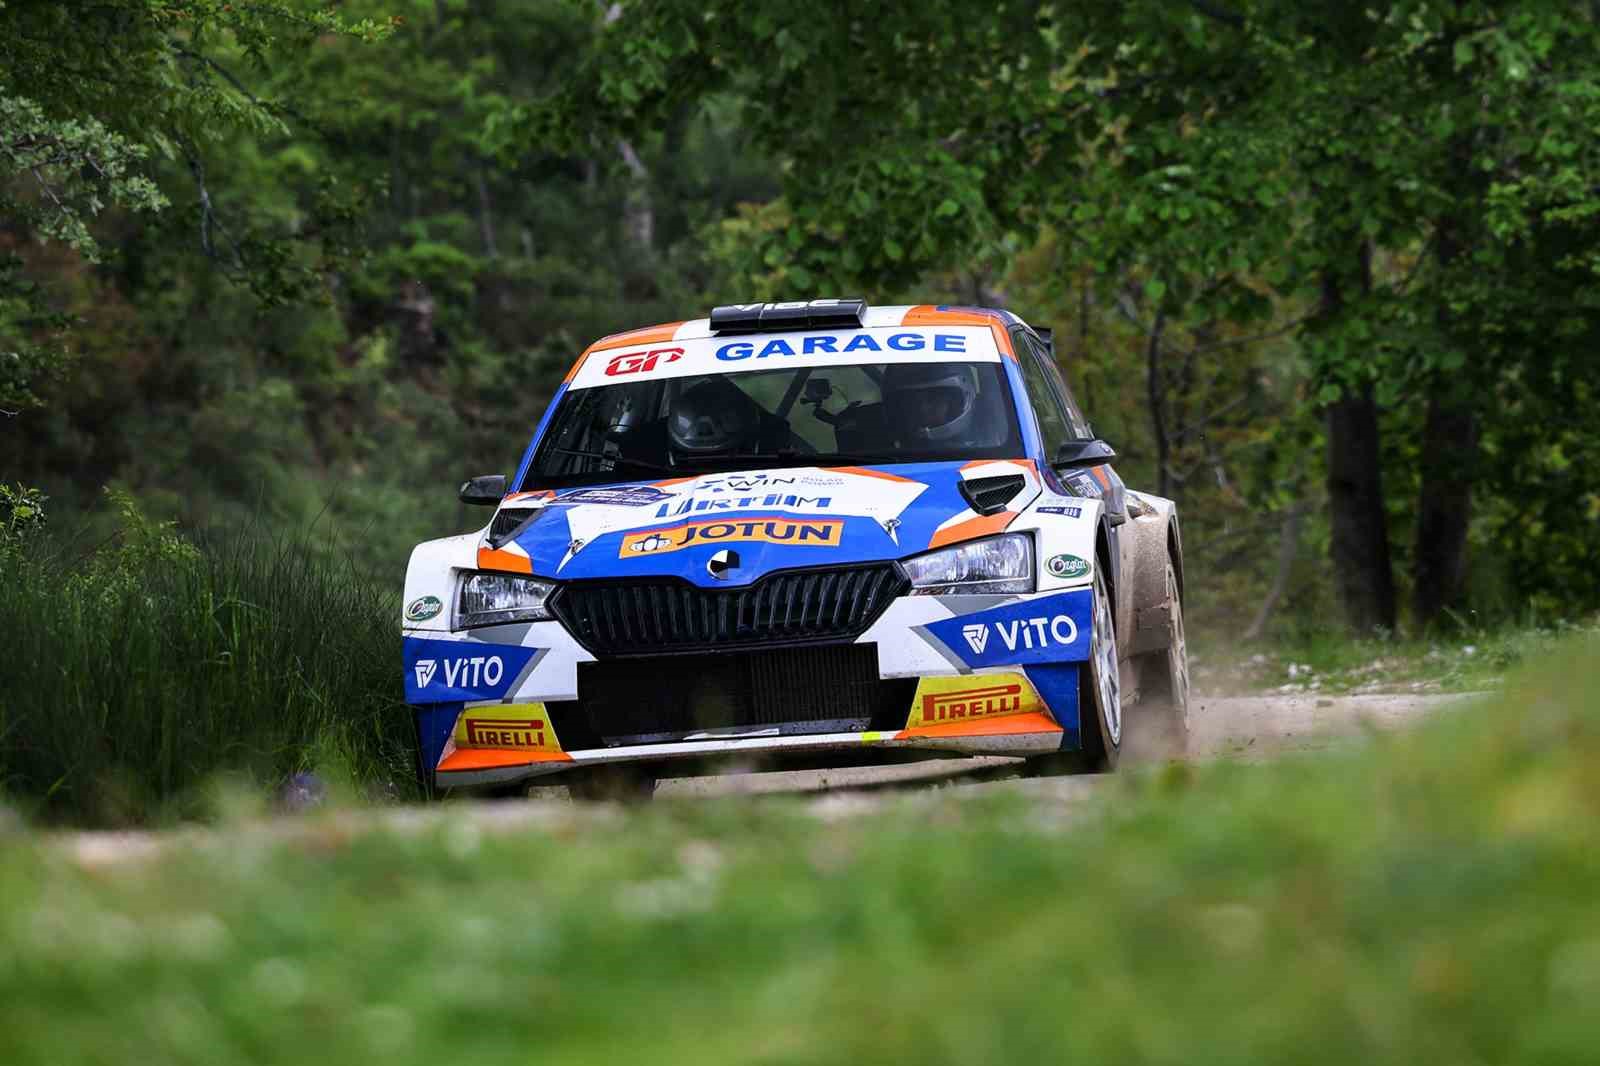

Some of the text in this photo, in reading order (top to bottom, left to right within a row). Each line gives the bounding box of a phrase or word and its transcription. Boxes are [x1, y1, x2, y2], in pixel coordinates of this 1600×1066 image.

[716, 333, 966, 362] GARAGE
[677, 520, 831, 546] JOTUN
[922, 684, 1022, 721] PIRELLI
[465, 718, 545, 746] PIRELLI
